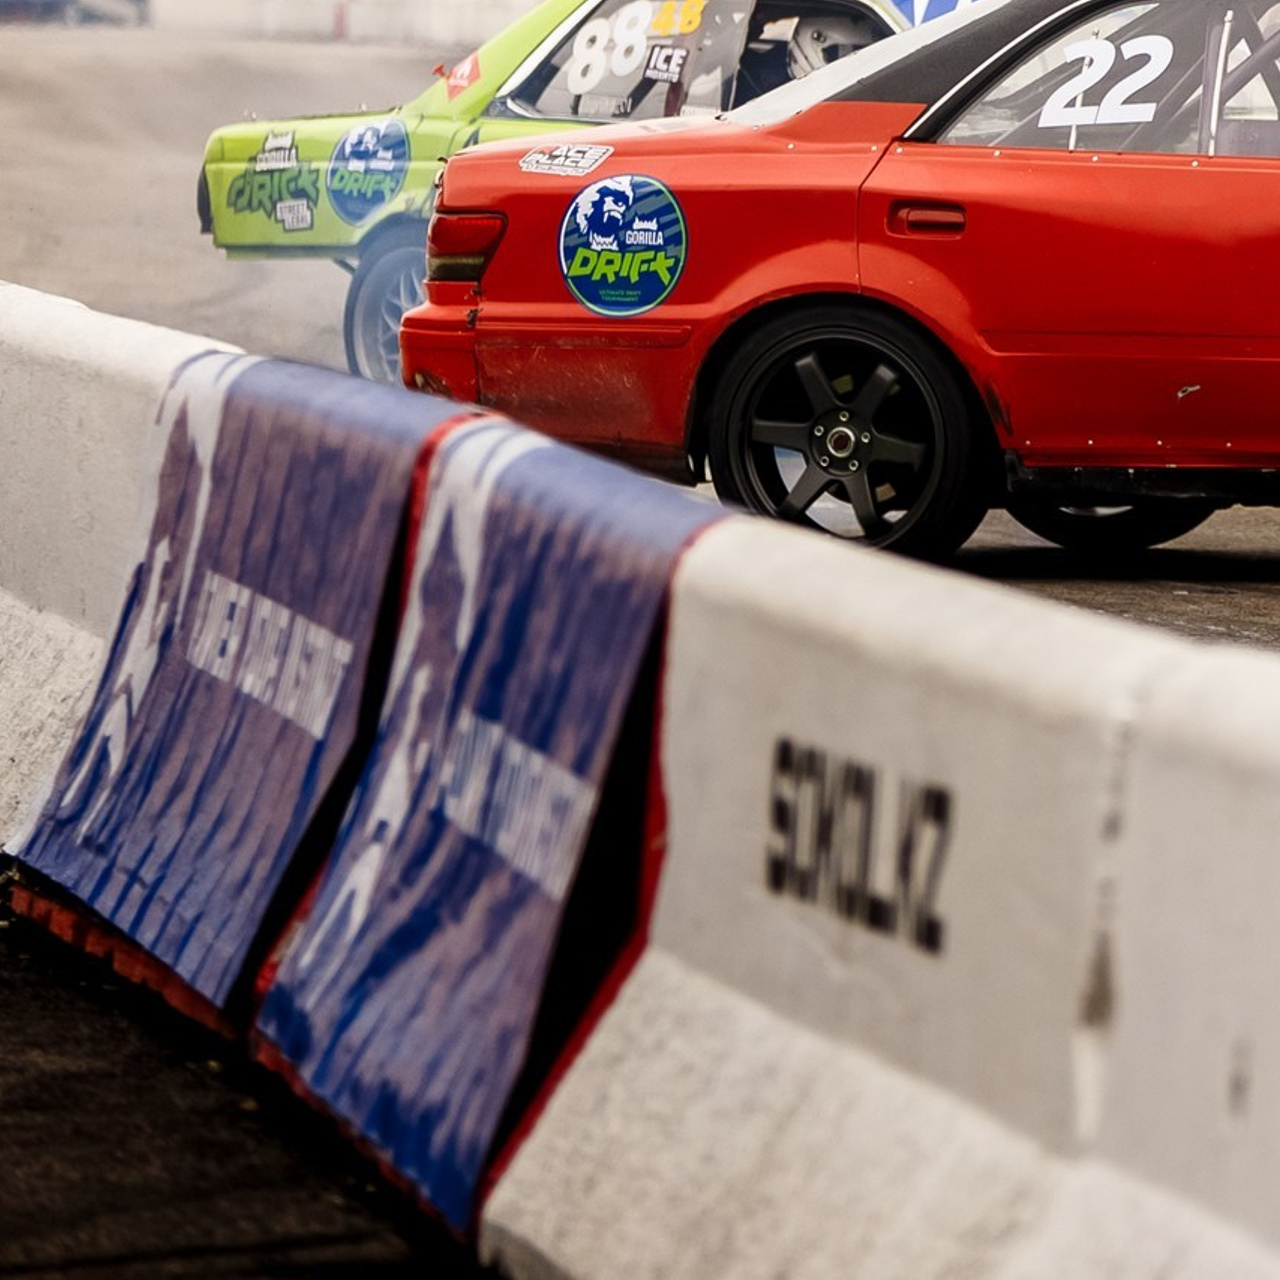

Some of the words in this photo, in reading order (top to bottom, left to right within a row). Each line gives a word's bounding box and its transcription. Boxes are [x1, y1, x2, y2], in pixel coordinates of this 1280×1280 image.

[649, 46, 688, 74] ICE
[1038, 35, 1174, 128] 22
[625, 230, 664, 246] GORILLA
